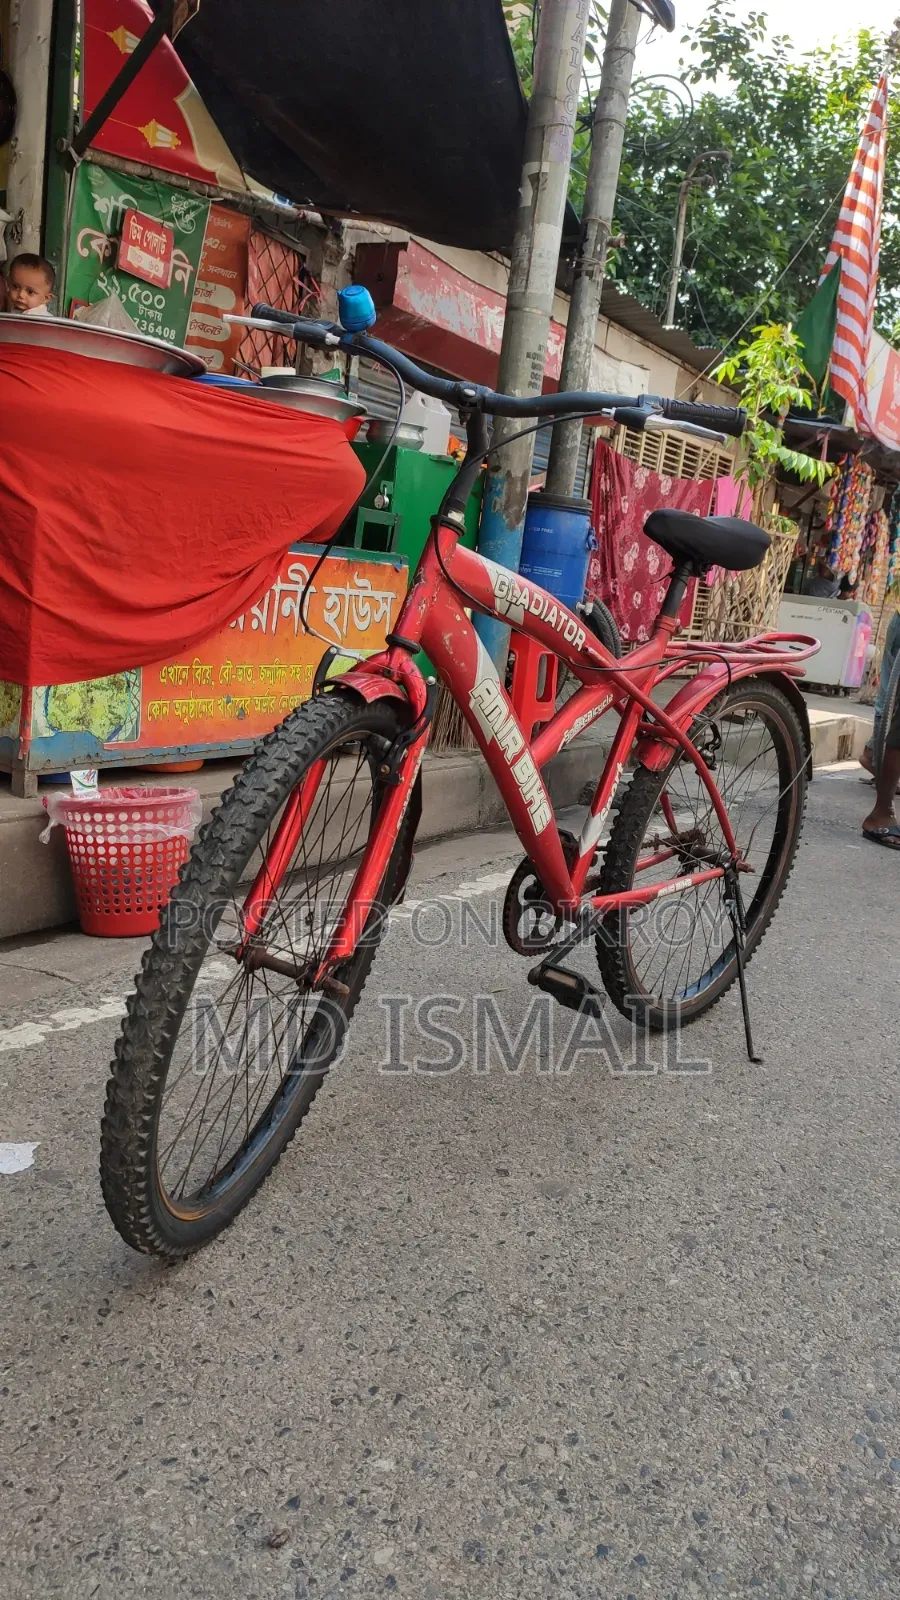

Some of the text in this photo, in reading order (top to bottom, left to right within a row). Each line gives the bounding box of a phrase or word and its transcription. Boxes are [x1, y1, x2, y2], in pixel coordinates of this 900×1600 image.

[129, 214, 143, 245] ডিম
[138, 303, 163, 322] টাকায়
[323, 571, 397, 643] হাউস
[494, 573, 587, 652] GLADIATOR
[159, 664, 190, 687] এখানে
[259, 657, 289, 687] জন্মদিন
[290, 664, 302, 684] সহ
[147, 698, 170, 721] কোন
[172, 689, 215, 725] অনুষ্ঠানের
[253, 688, 277, 716] অর্ডার
[510, 747, 553, 836] BIKE
